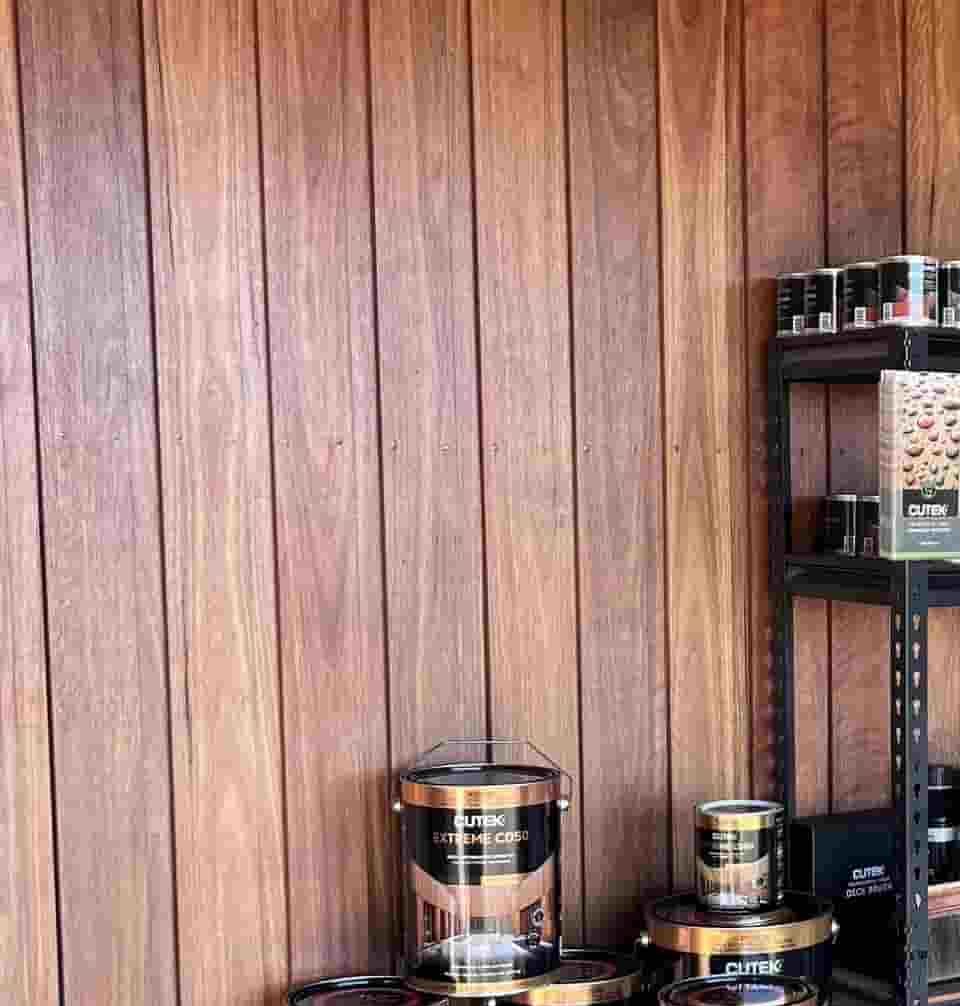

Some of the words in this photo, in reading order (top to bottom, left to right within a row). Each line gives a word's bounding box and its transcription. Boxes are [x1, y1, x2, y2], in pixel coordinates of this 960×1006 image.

[908, 504, 949, 517] CUTEK
[454, 813, 506, 829] CUTEK
[433, 831, 493, 846] EXTREME
[495, 830, 529, 844] CD50
[725, 959, 784, 976] CUTEK
